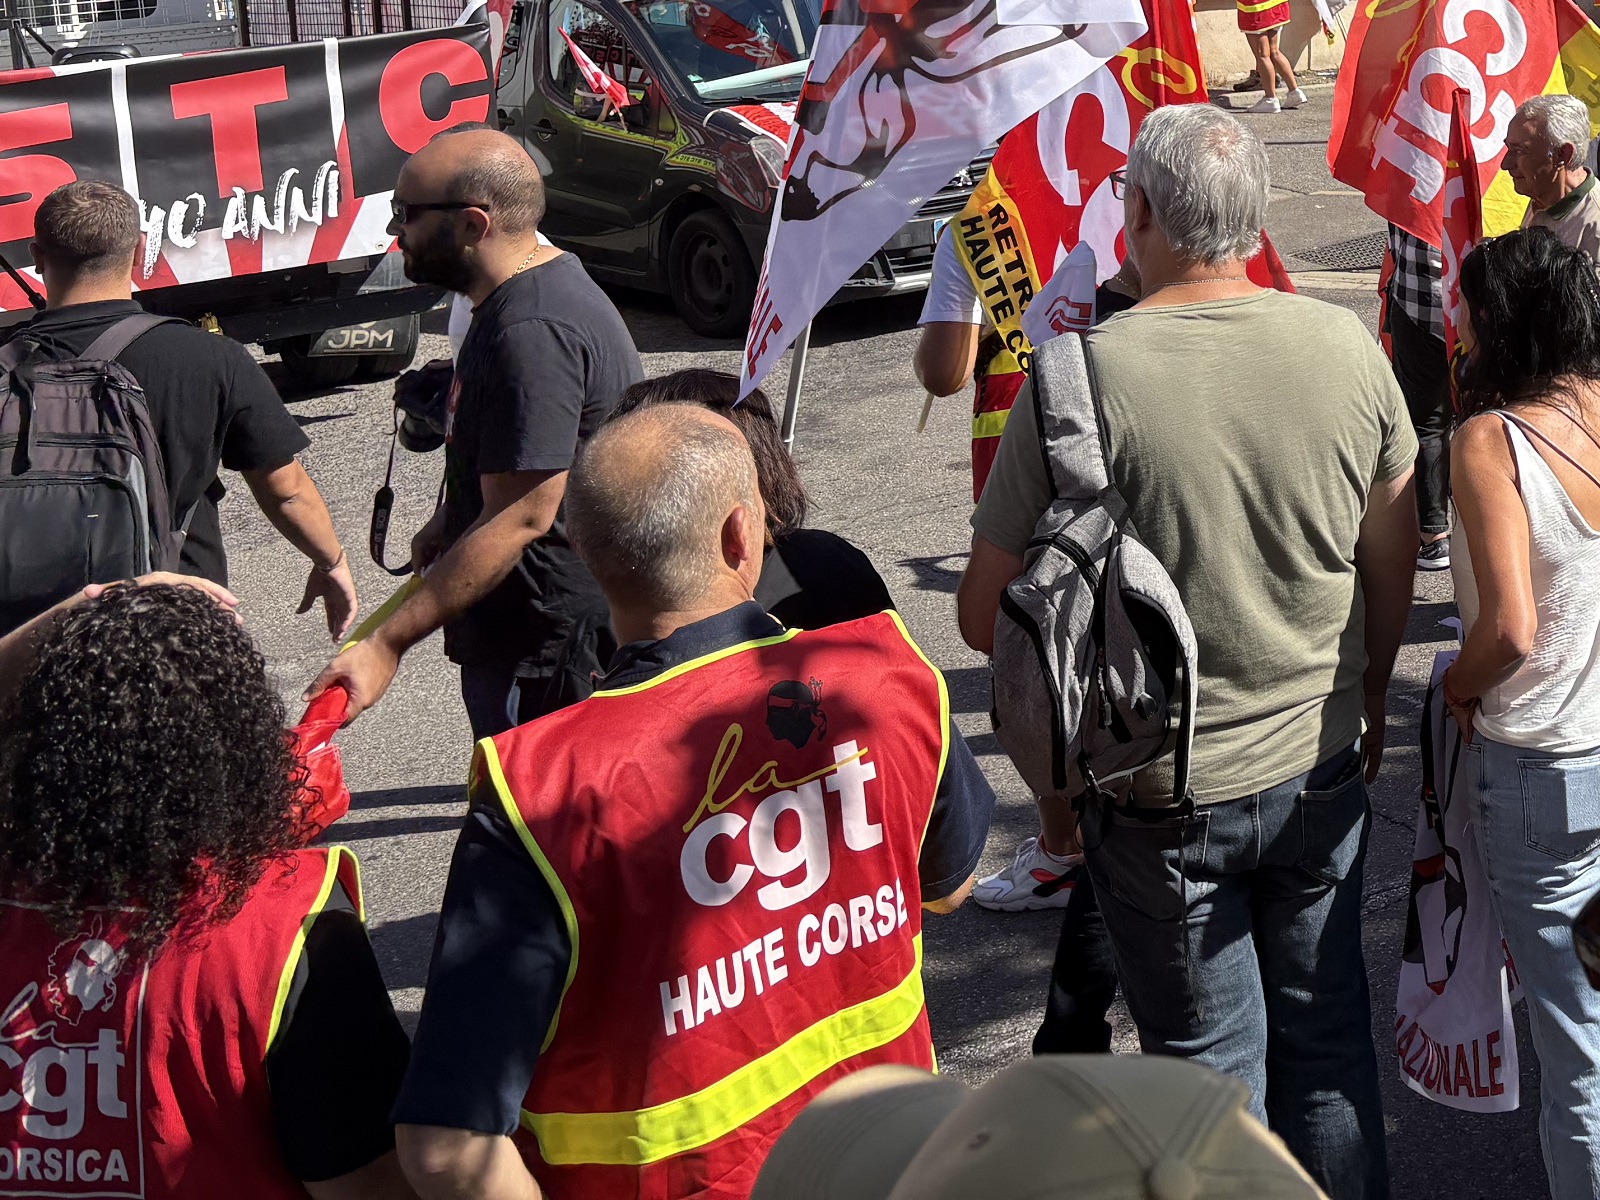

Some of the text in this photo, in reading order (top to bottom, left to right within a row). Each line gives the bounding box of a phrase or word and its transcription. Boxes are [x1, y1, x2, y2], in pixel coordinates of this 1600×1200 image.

[221, 160, 340, 241] ANNI
[960, 215, 1015, 325] HAUTE
[327, 326, 395, 350] JPM
[680, 739, 883, 911] cgt
[682, 723, 868, 833] la
[660, 877, 908, 1036] HAUTE CORSE
[0, 1148, 130, 1183] ORSICA
